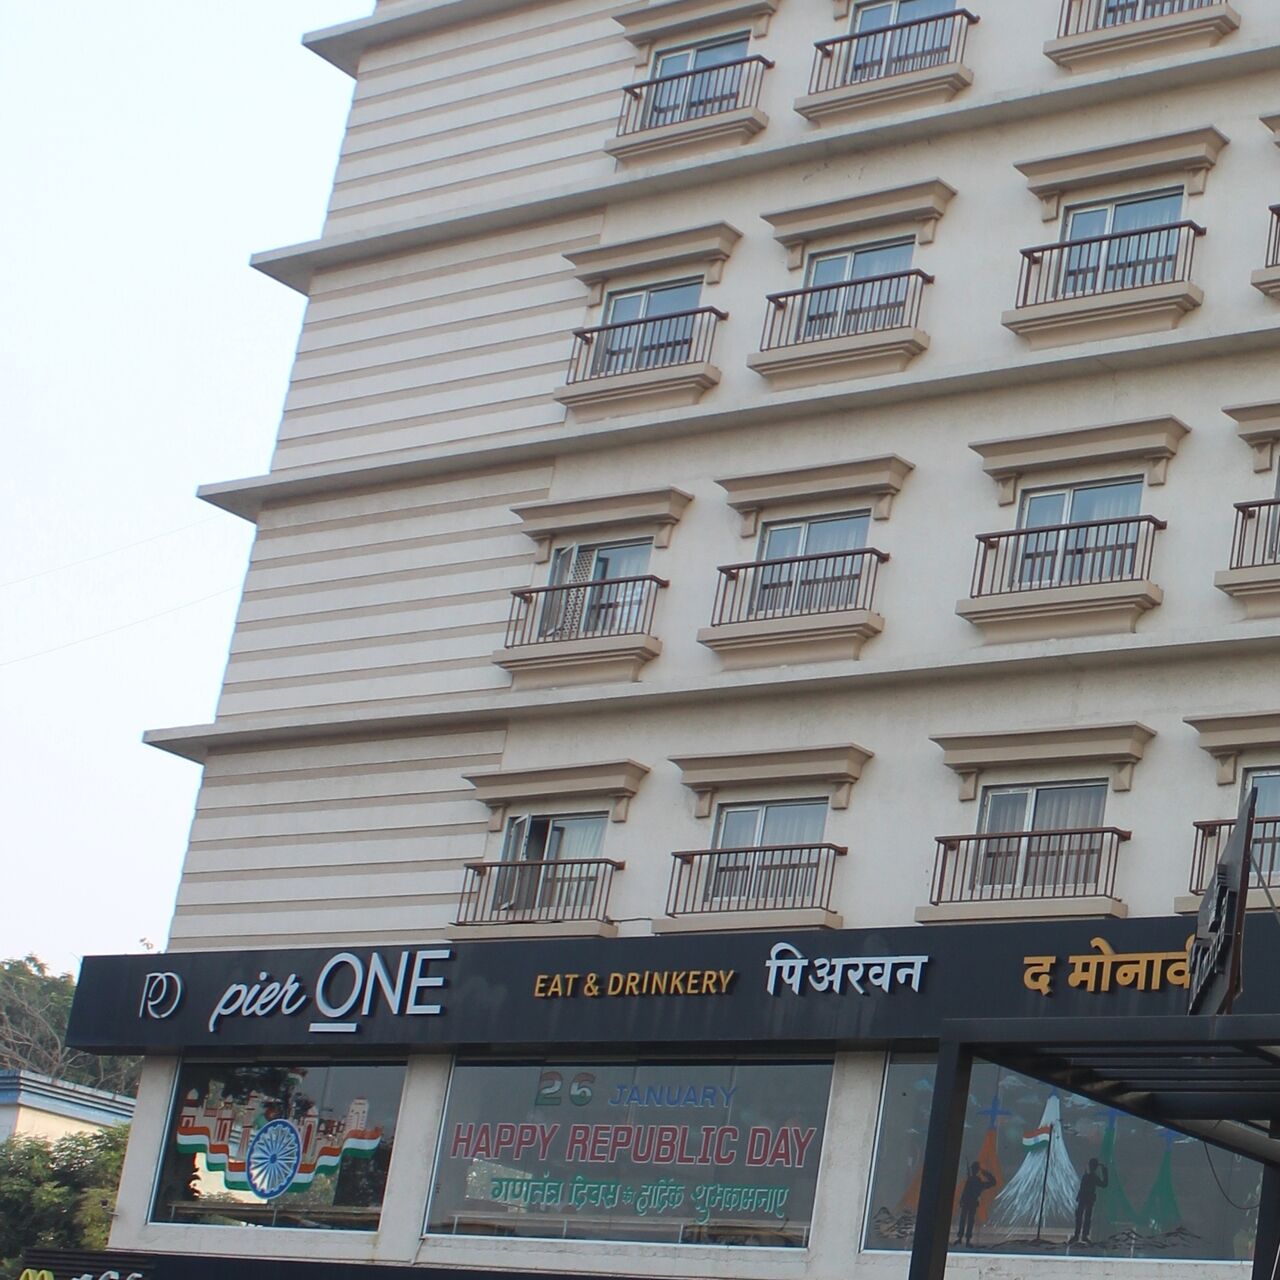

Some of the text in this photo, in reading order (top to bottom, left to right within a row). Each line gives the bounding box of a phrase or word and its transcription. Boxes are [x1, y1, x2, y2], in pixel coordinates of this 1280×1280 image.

[208, 949, 451, 1032] pier ONE
[534, 969, 735, 998] EAT & DRINKERY
[1023, 955, 1057, 997] द
[535, 1070, 739, 1109] 26 JANUARY
[450, 1122, 818, 1168] HAPPY REPUBLIC DAY
